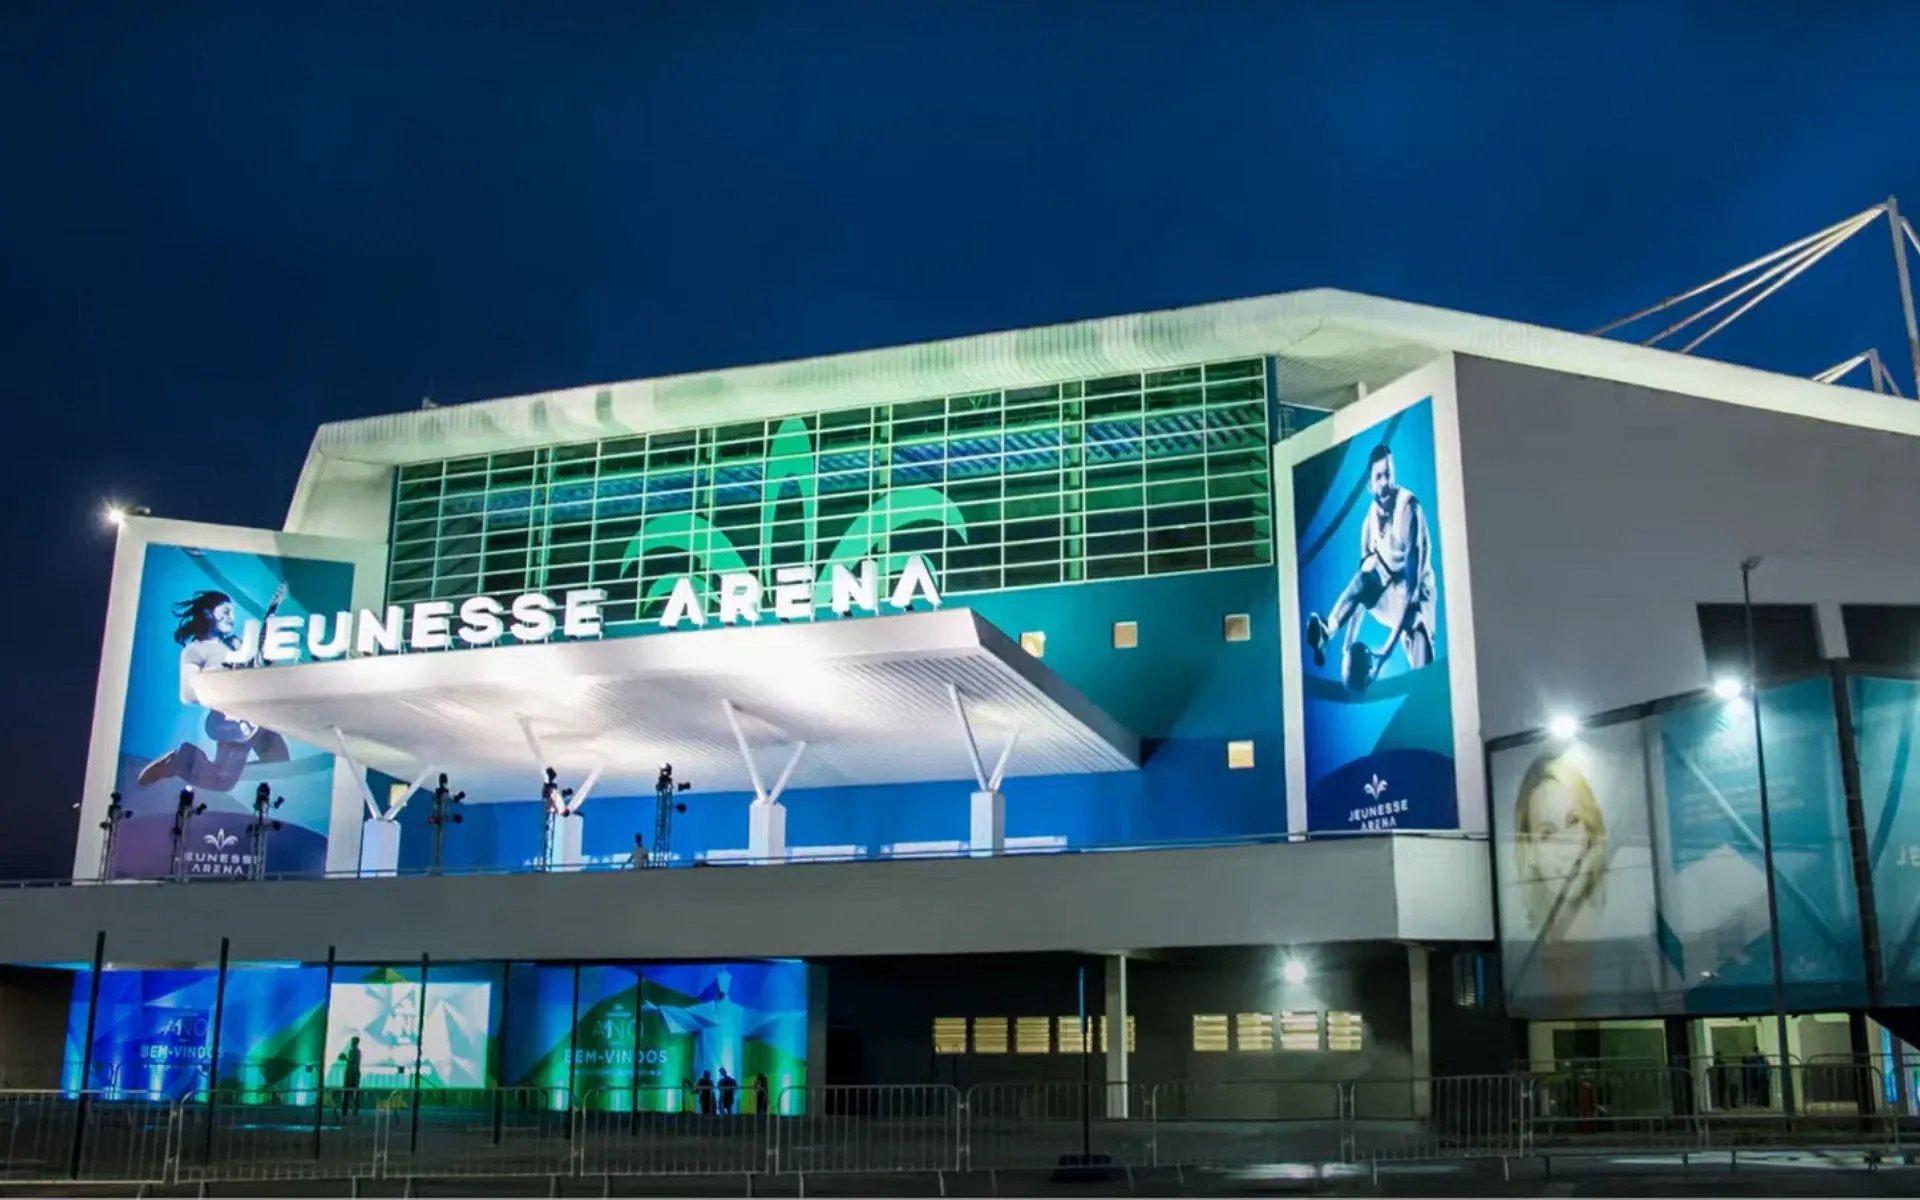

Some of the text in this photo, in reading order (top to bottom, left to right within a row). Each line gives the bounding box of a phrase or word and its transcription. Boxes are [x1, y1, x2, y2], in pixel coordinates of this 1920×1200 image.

[223, 553, 943, 665] JEUNESSE ARENA
[1348, 798, 1409, 823] JEUNESSE
[1359, 815, 1398, 832] ARENA
[174, 851, 262, 865] EUNESS
[191, 863, 243, 875] ARENA
[563, 1047, 668, 1064] BEM-VINDOS
